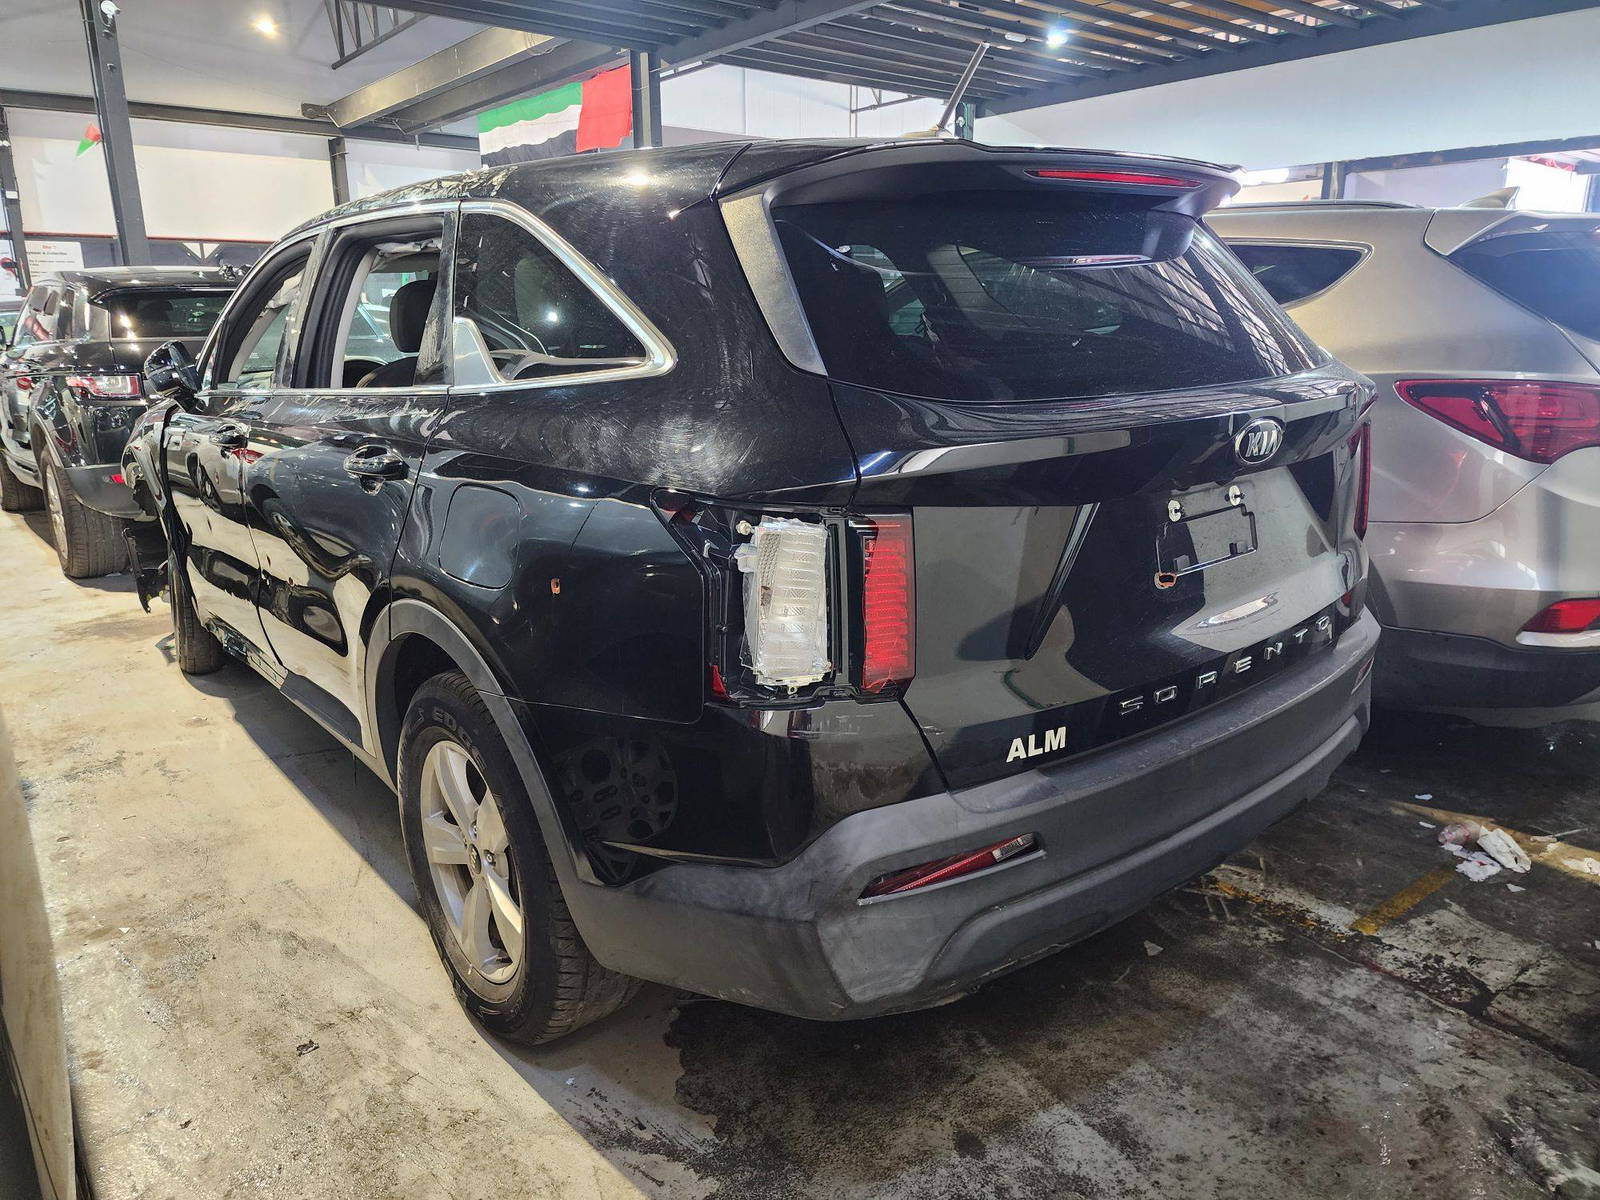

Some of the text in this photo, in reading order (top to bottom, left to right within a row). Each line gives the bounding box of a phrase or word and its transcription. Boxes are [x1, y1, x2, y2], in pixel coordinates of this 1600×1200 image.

[1245, 430, 1278, 457] KIA
[1120, 615, 1331, 715] SORENTO
[1006, 726, 1066, 763] ALM
